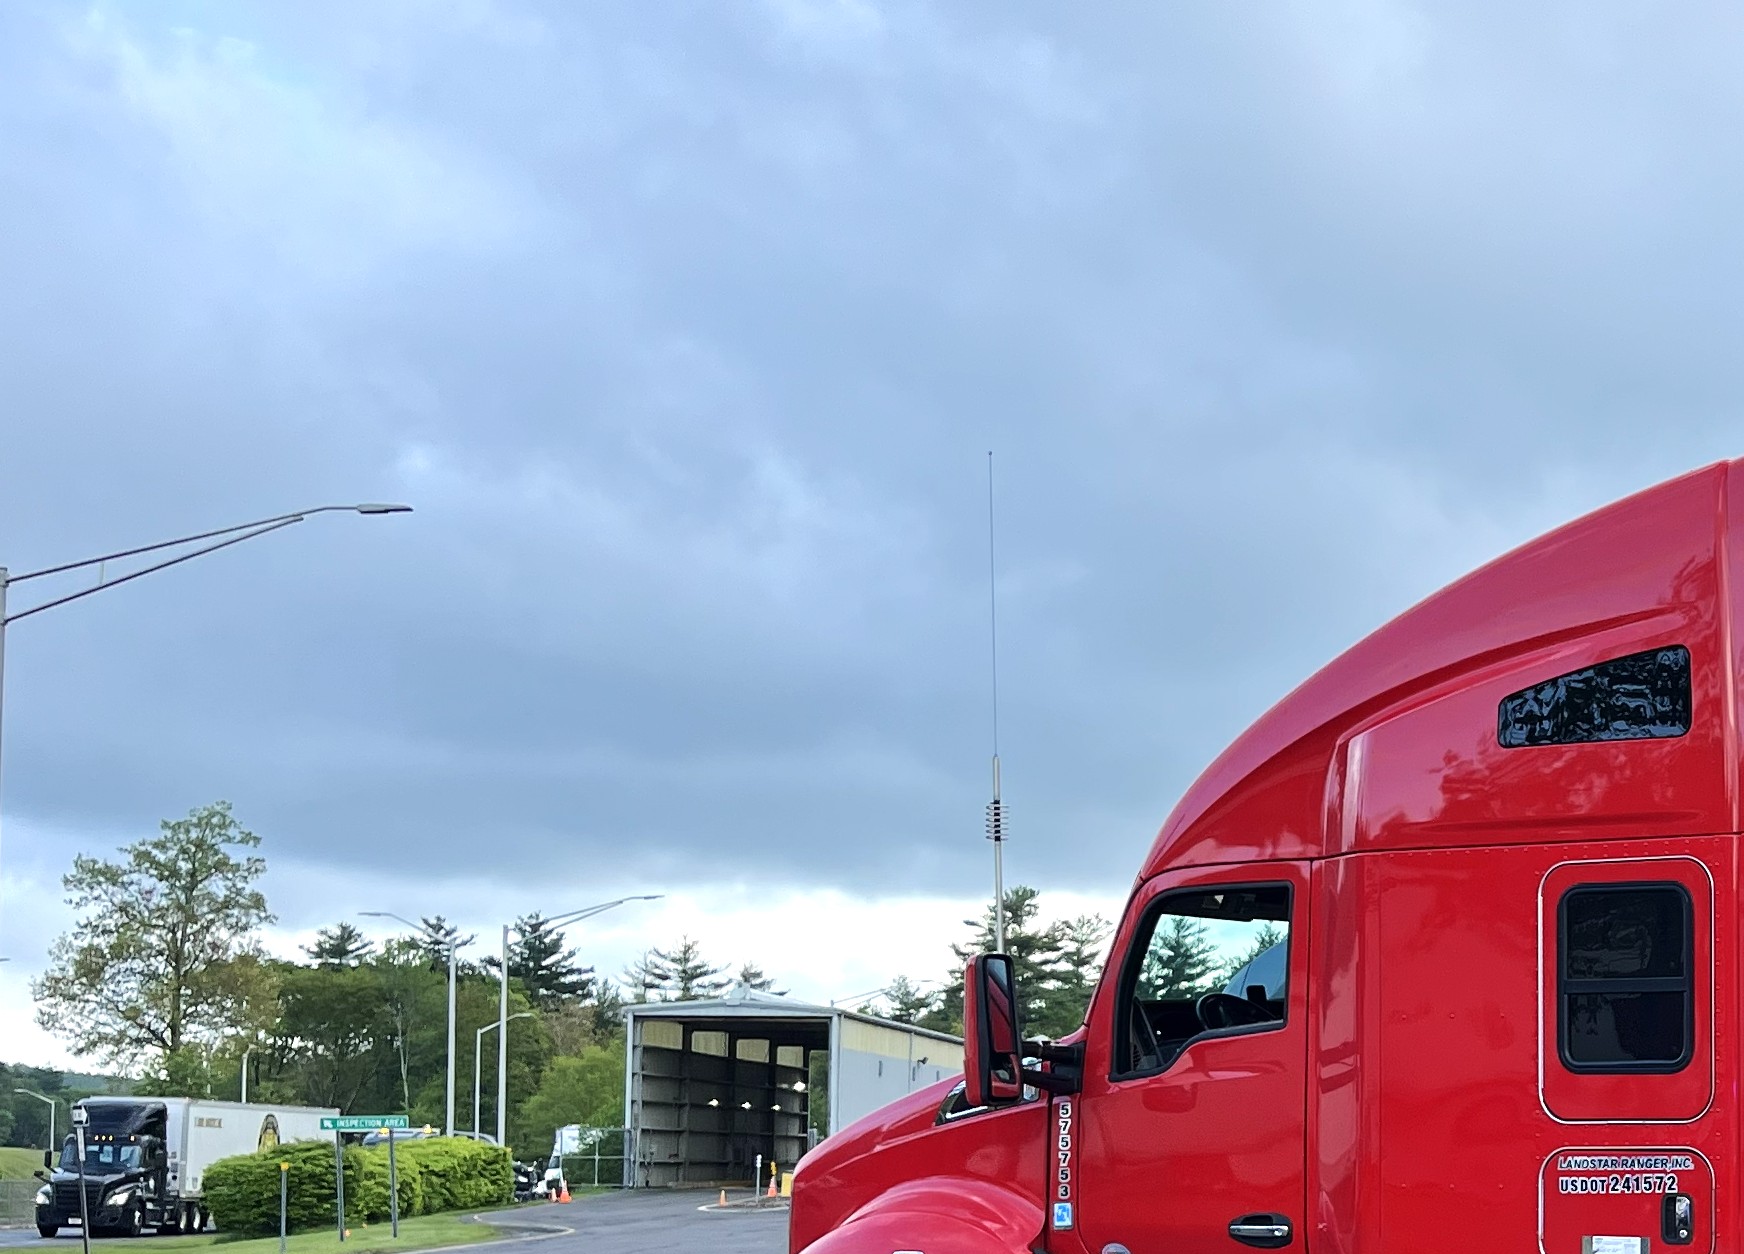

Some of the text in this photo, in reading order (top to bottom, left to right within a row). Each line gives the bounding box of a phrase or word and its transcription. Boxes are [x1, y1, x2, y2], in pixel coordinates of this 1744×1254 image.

[336, 1119, 405, 1128] INSPECTION AREA
[1058, 1102, 1071, 1199] 575753
[1559, 1157, 1618, 1170] LANDSTAR
[1560, 1174, 1678, 1193] USDOT 241572
